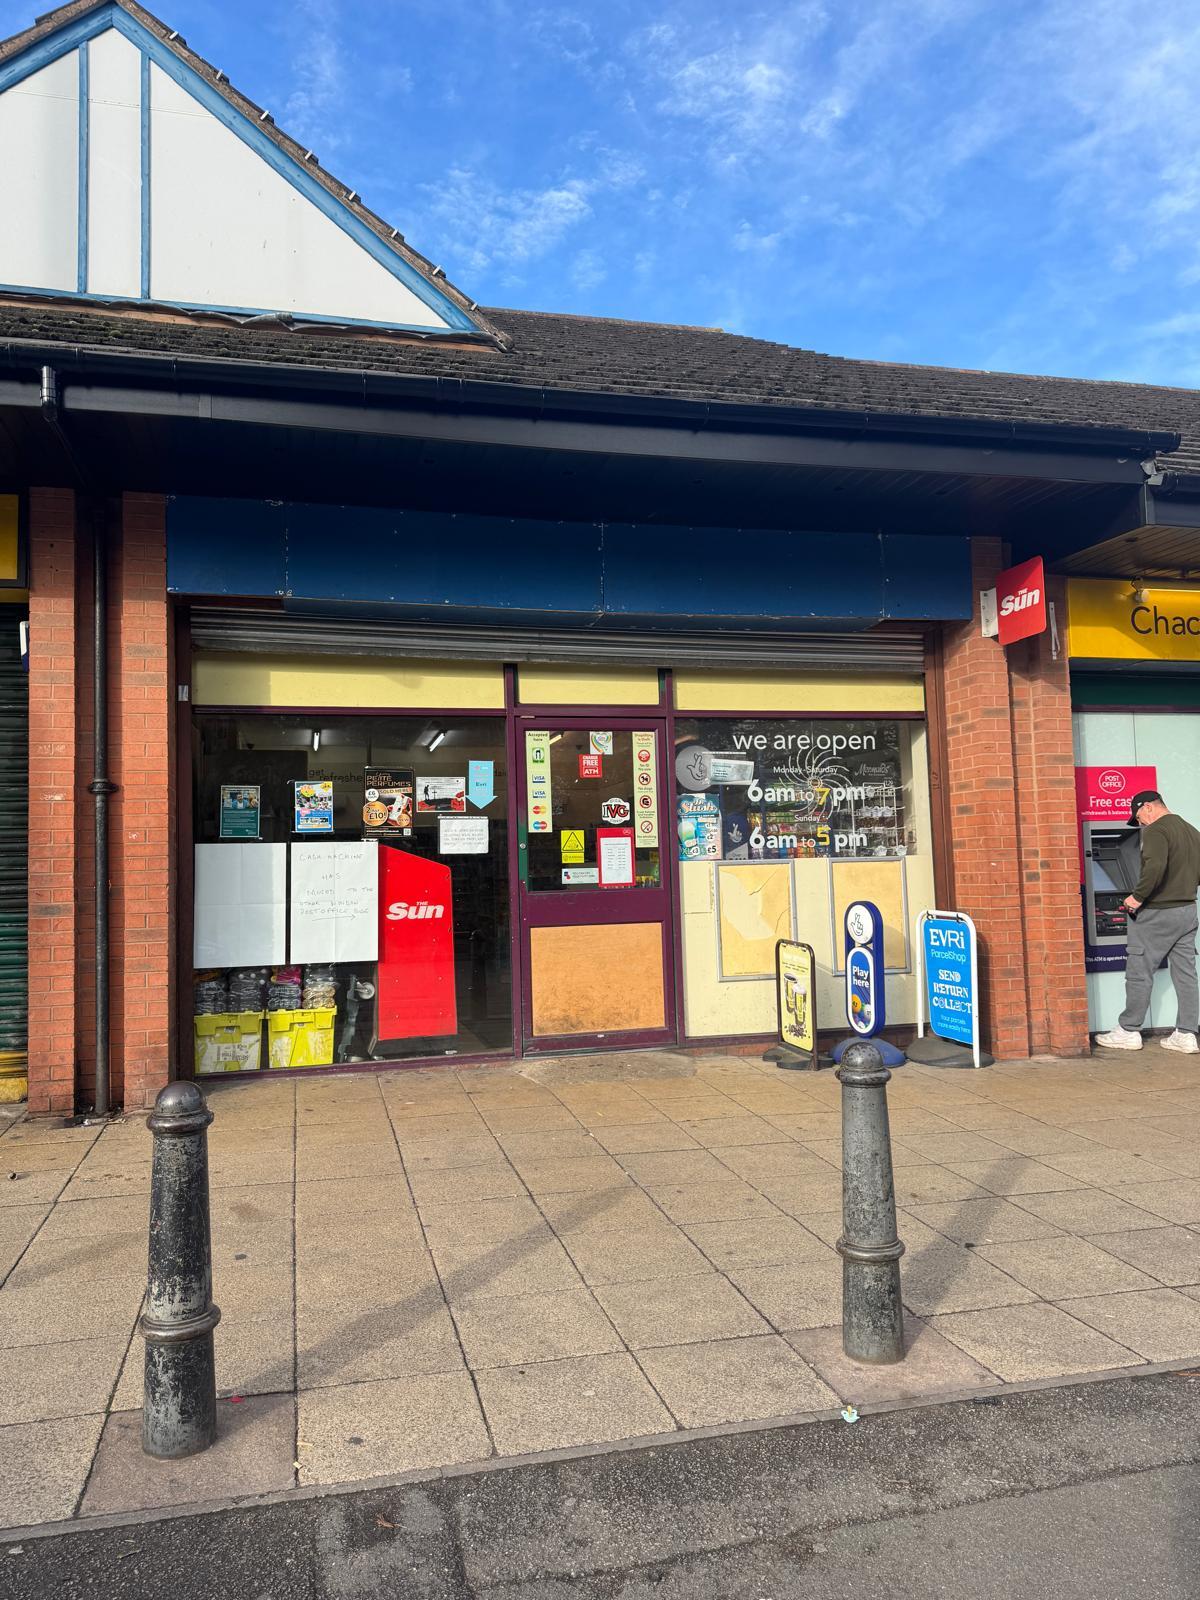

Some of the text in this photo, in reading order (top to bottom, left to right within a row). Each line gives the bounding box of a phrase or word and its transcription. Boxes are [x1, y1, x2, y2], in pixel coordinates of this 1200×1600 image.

[1017, 588, 1028, 597] THE
[1000, 588, 1041, 617] Sun
[1131, 605, 1200, 636] Chac
[733, 734, 876, 756] we are open
[320, 771, 364, 783] refreshe
[773, 766, 802, 775] Monday
[806, 766, 839, 775] Saturday
[747, 778, 866, 807] 6am to 7 pm
[1089, 795, 1135, 808] Free cas
[602, 803, 630, 819] IVG
[794, 814, 821, 824] Sunday
[749, 825, 868, 853] 6am to 5 pm
[299, 854, 321, 862] CASH
[385, 901, 445, 921] Sun
[930, 948, 967, 965] ParcelShop
[852, 965, 870, 980] Play
[938, 969, 962, 983] SEND
[852, 976, 870, 988] here
[932, 982, 969, 999] RETURN
[932, 996, 972, 1014] COLLECT
